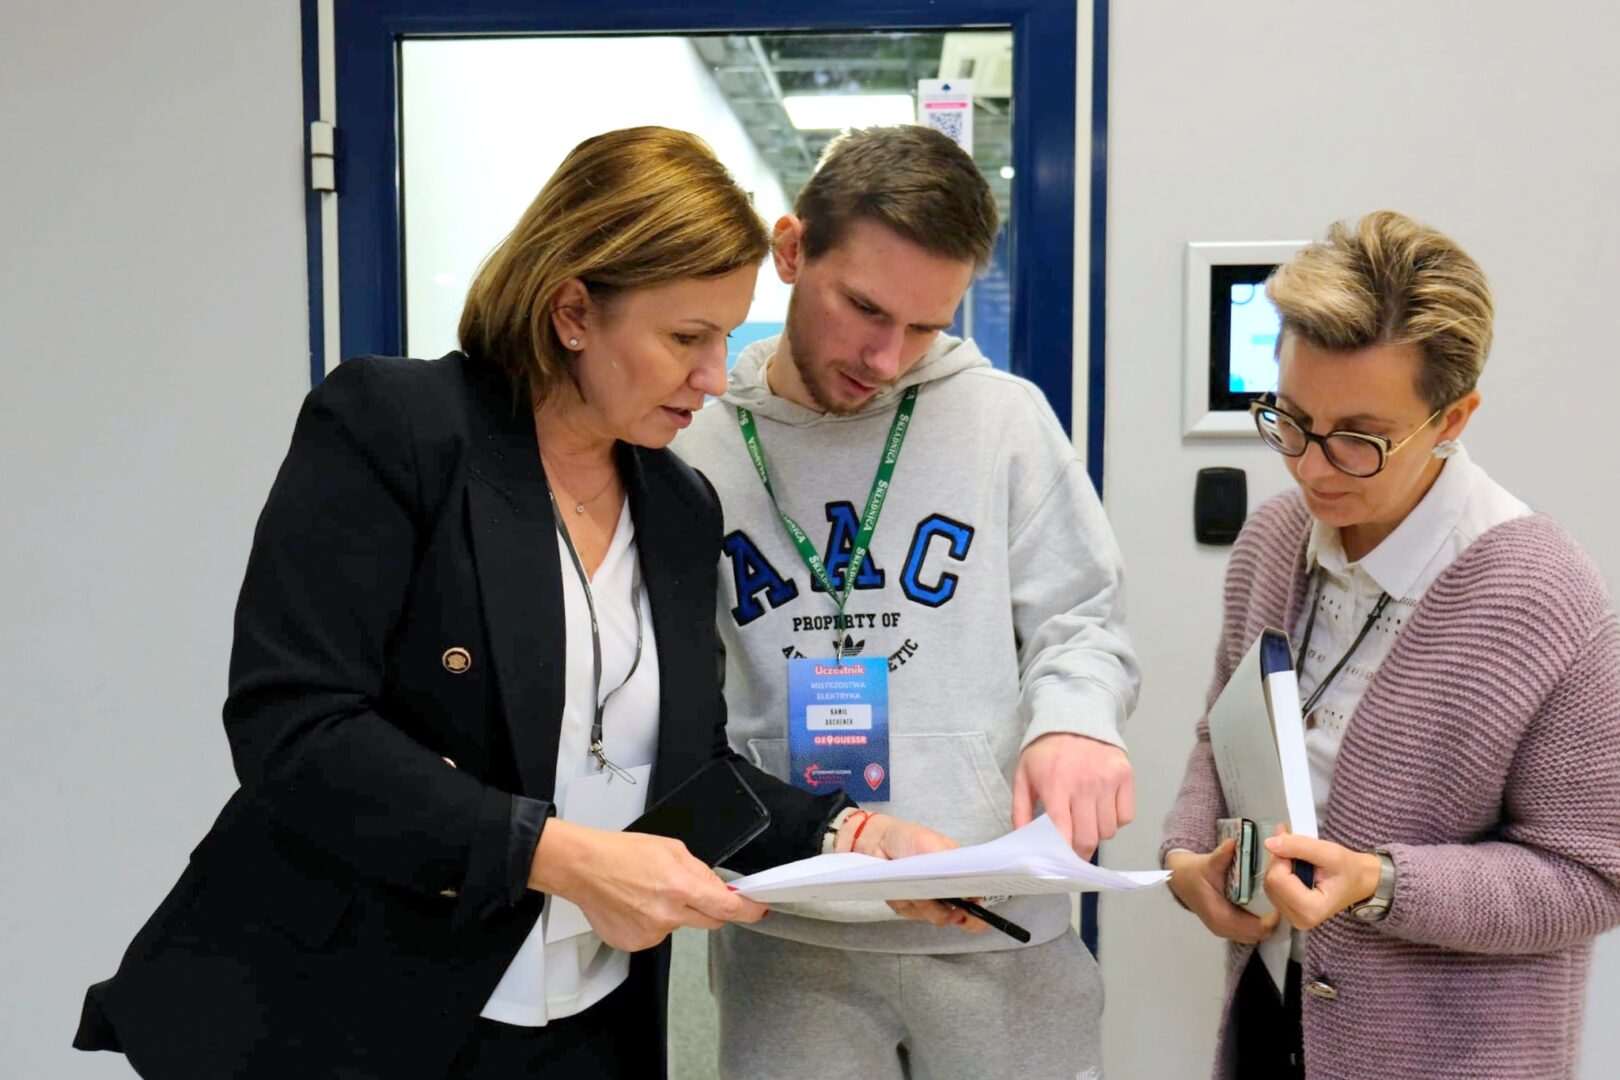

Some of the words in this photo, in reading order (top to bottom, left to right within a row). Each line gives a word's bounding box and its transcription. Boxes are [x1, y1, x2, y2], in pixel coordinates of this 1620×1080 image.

[863, 479, 889, 531] SKŁADNICA
[792, 613, 876, 632] PROPERTY
[881, 612, 901, 629] OF
[814, 664, 866, 676] Uczestnik
[810, 681, 867, 690] MISTRZOSTWA
[816, 692, 861, 700] ELEKTRYKA
[830, 708, 848, 716] KAMIL
